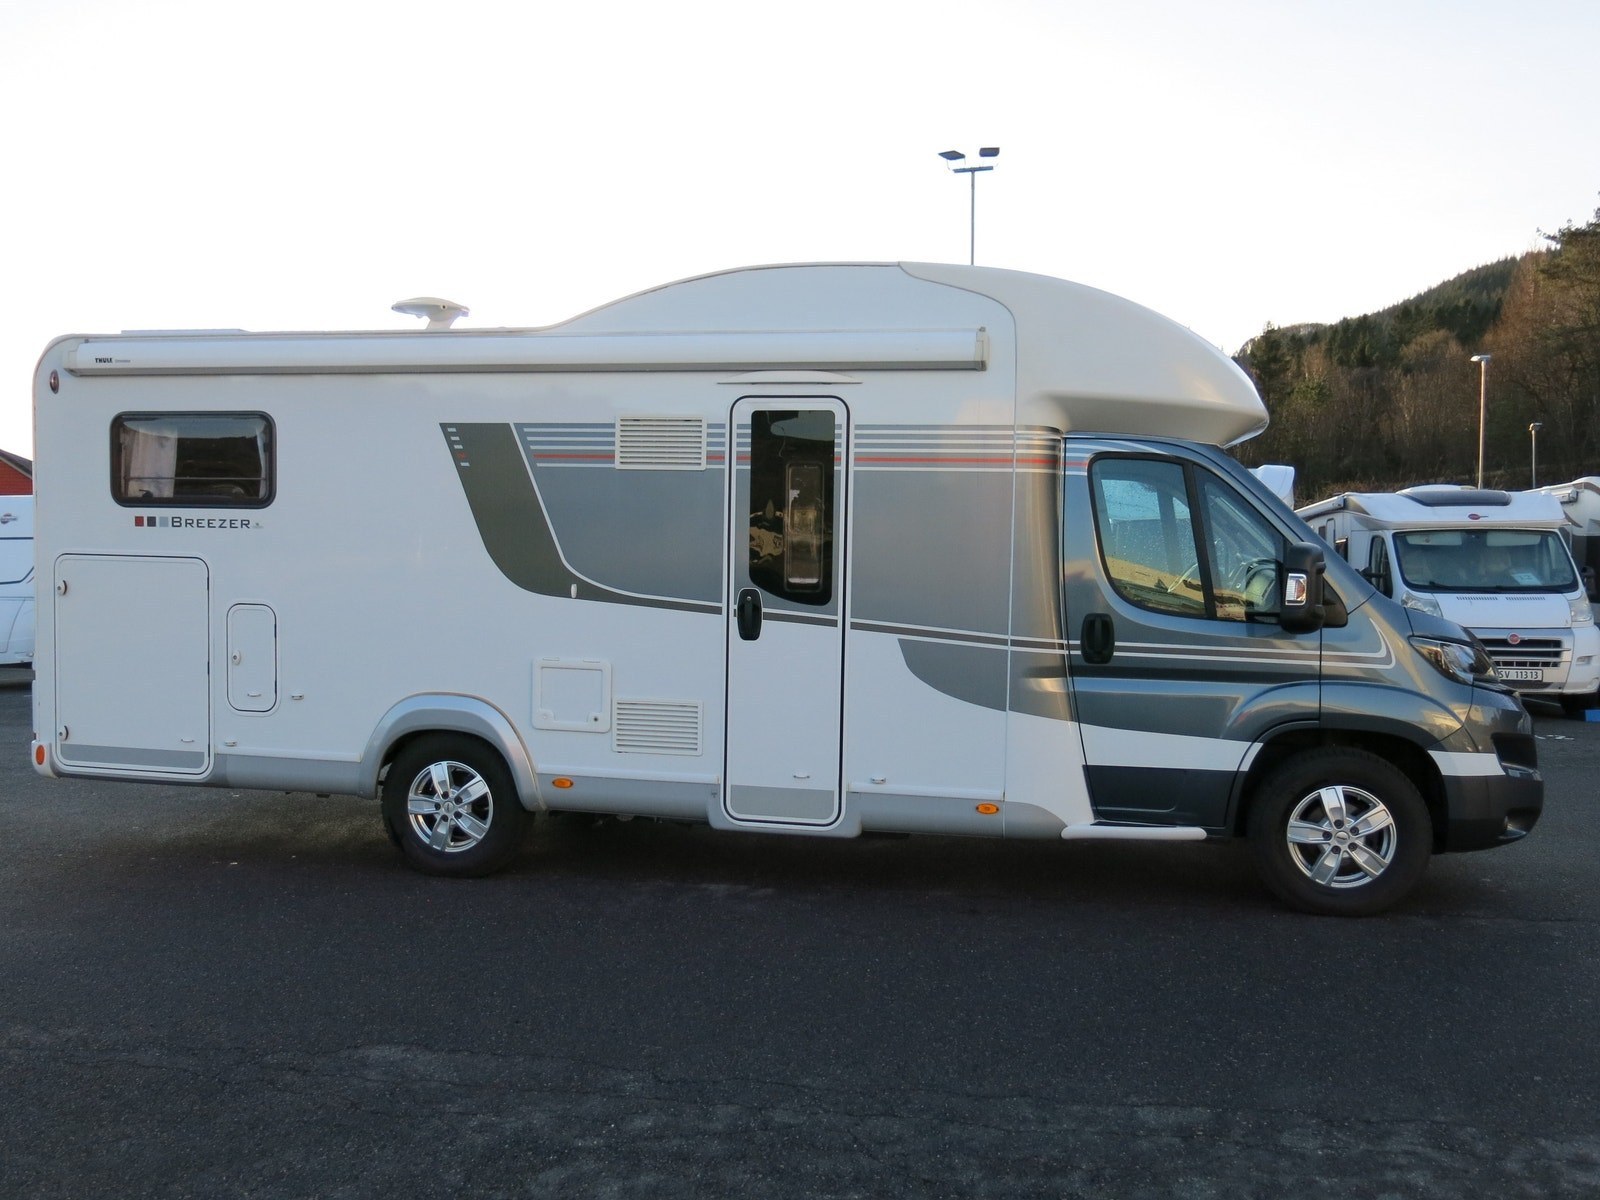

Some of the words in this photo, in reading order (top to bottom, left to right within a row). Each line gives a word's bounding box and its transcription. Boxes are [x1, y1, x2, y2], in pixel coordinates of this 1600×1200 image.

[171, 516, 250, 529] BREEZER
[1499, 670, 1510, 679] SV
[1515, 670, 1539, 680] 11313
